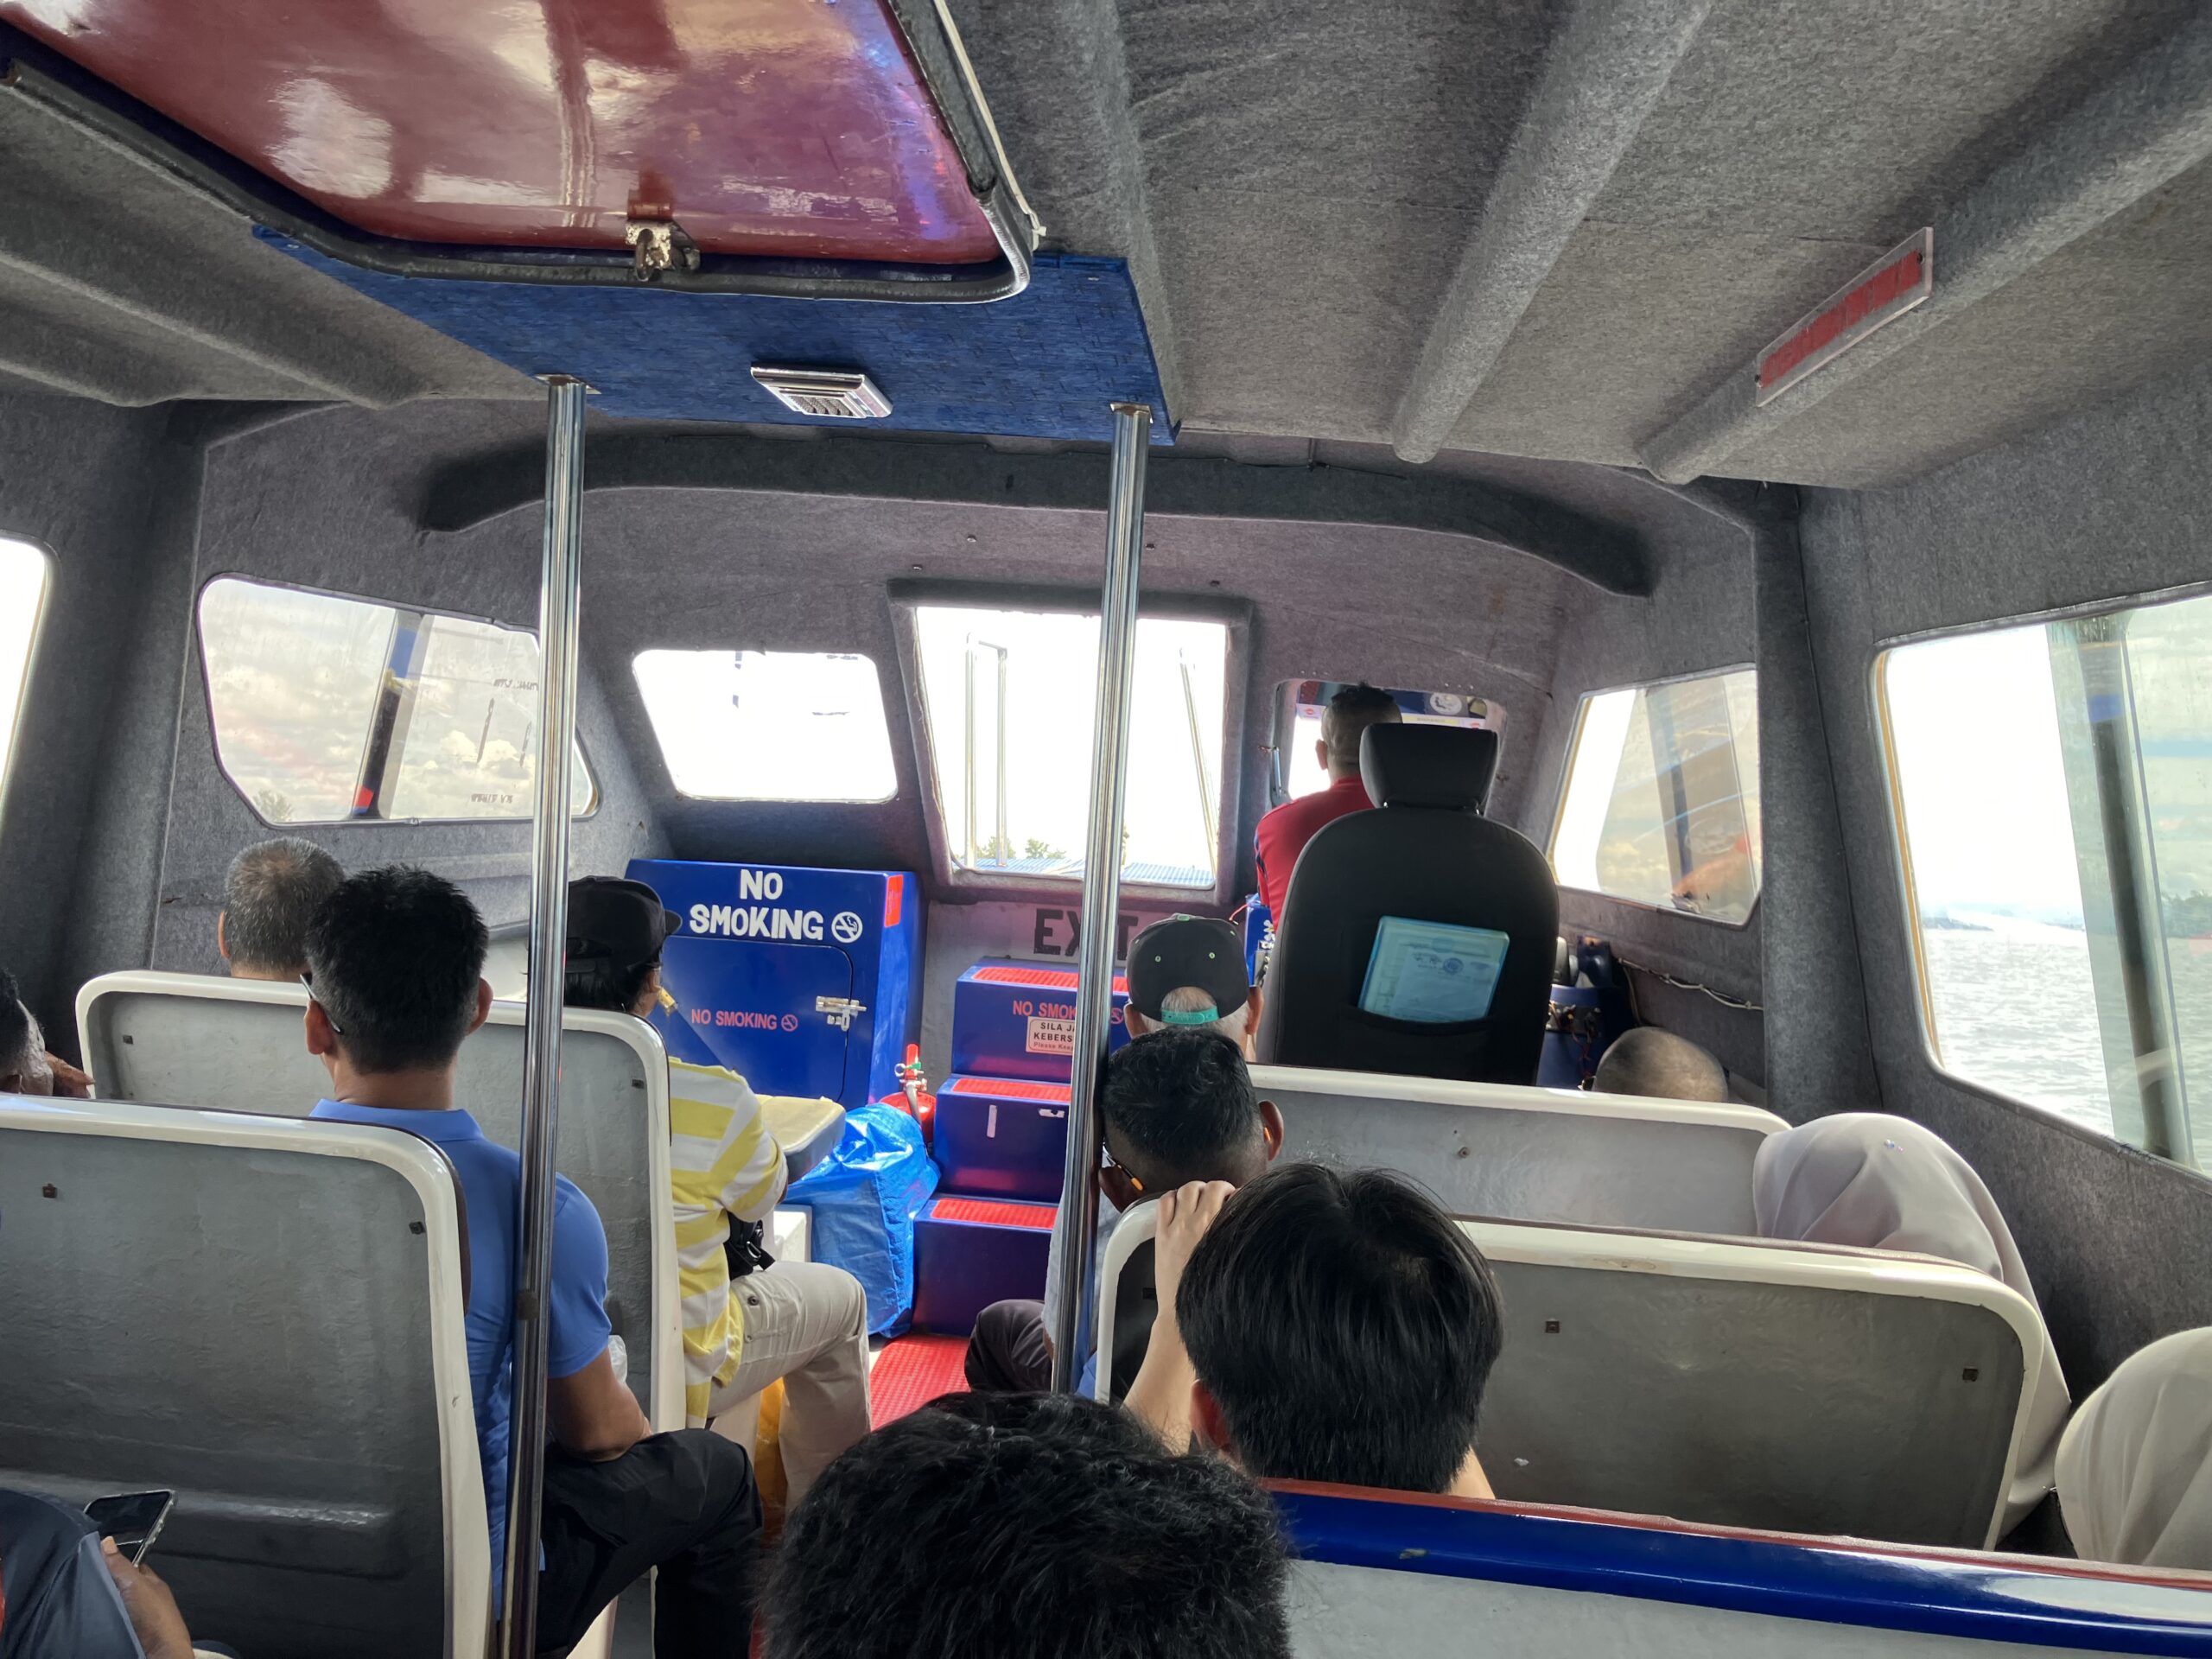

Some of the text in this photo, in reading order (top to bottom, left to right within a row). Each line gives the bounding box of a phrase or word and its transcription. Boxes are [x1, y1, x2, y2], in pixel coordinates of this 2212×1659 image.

[740, 868, 784, 900] NO
[690, 904, 823, 941] SMOKING
[1033, 908, 1139, 961] EXT
[691, 1008, 778, 1031] NO SMOKING
[1013, 1001, 1077, 1020] NO SMOK
[1033, 1032, 1073, 1043] KEBERS
[1040, 1021, 1063, 1032] SILA
